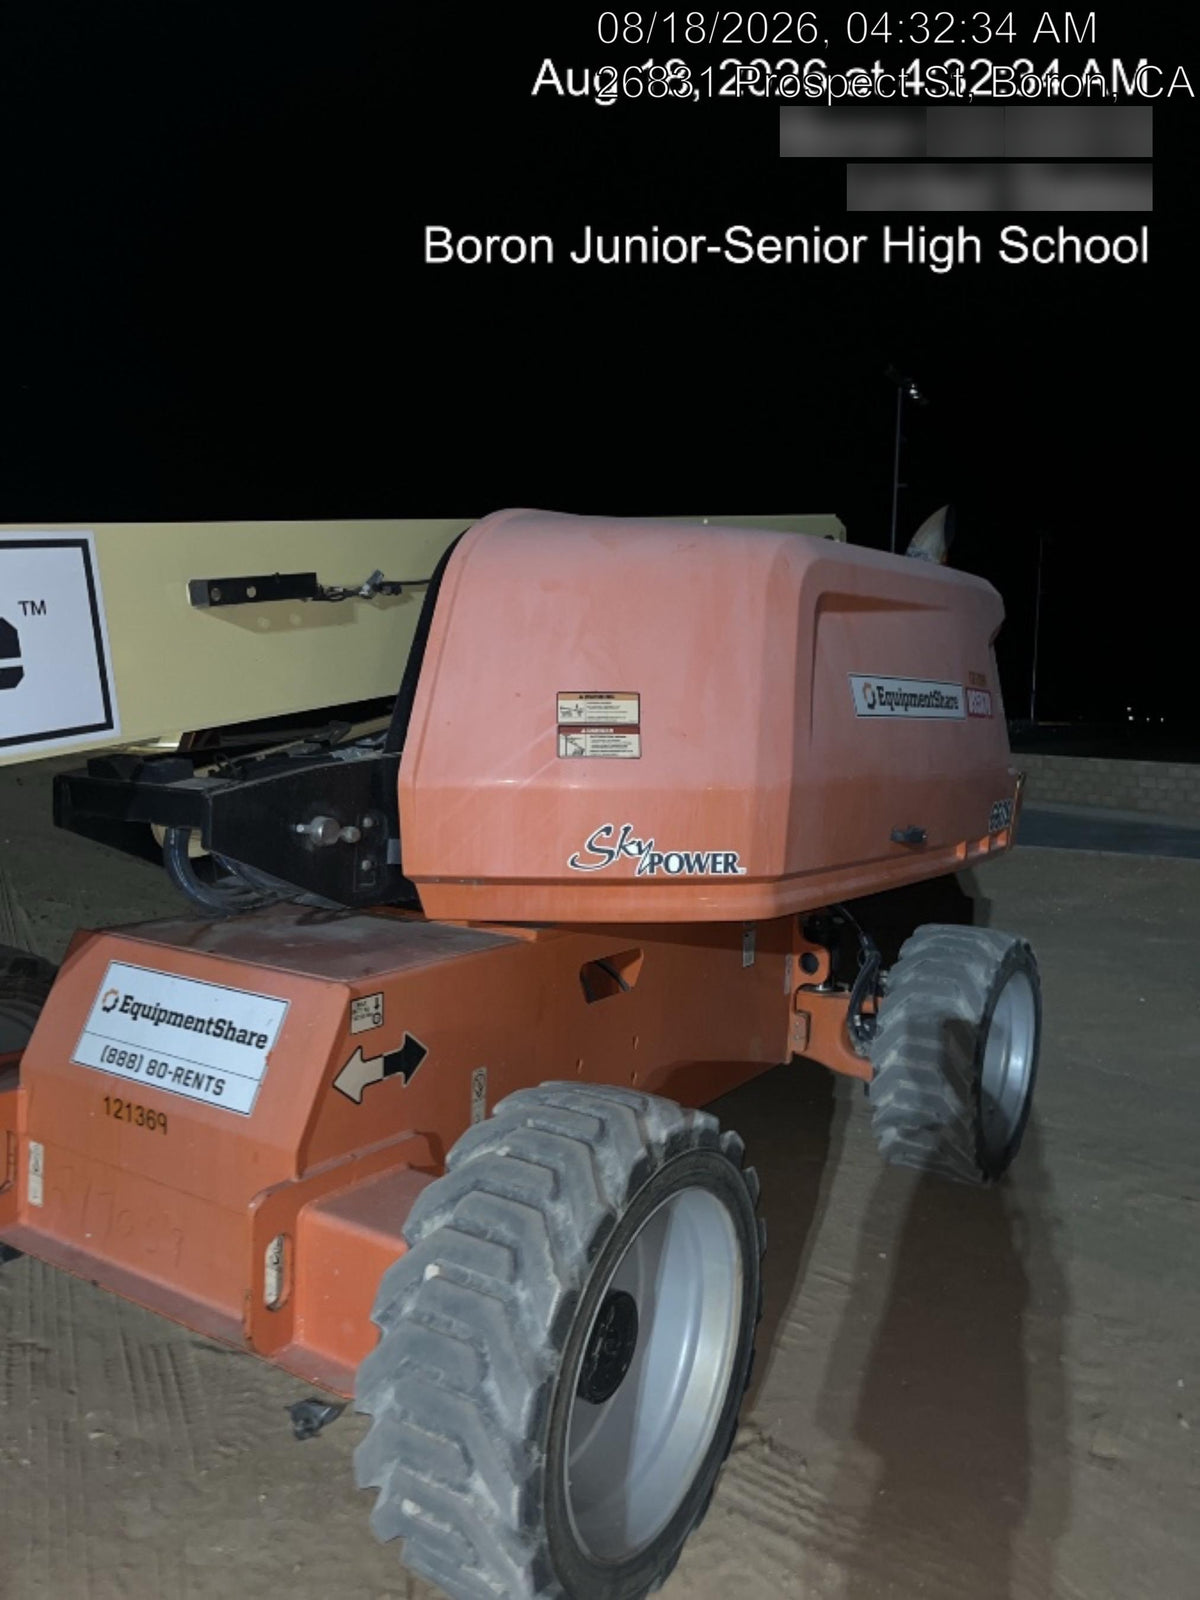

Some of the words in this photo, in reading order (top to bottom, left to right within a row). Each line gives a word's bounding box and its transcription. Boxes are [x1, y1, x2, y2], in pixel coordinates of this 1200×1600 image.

[876, 685, 960, 712] EquipmentShare
[118, 994, 269, 1050] EquipmentShare
[101, 1044, 145, 1072] (888)
[145, 1058, 227, 1096] 80-RENTS
[103, 1096, 169, 1136] 121369
